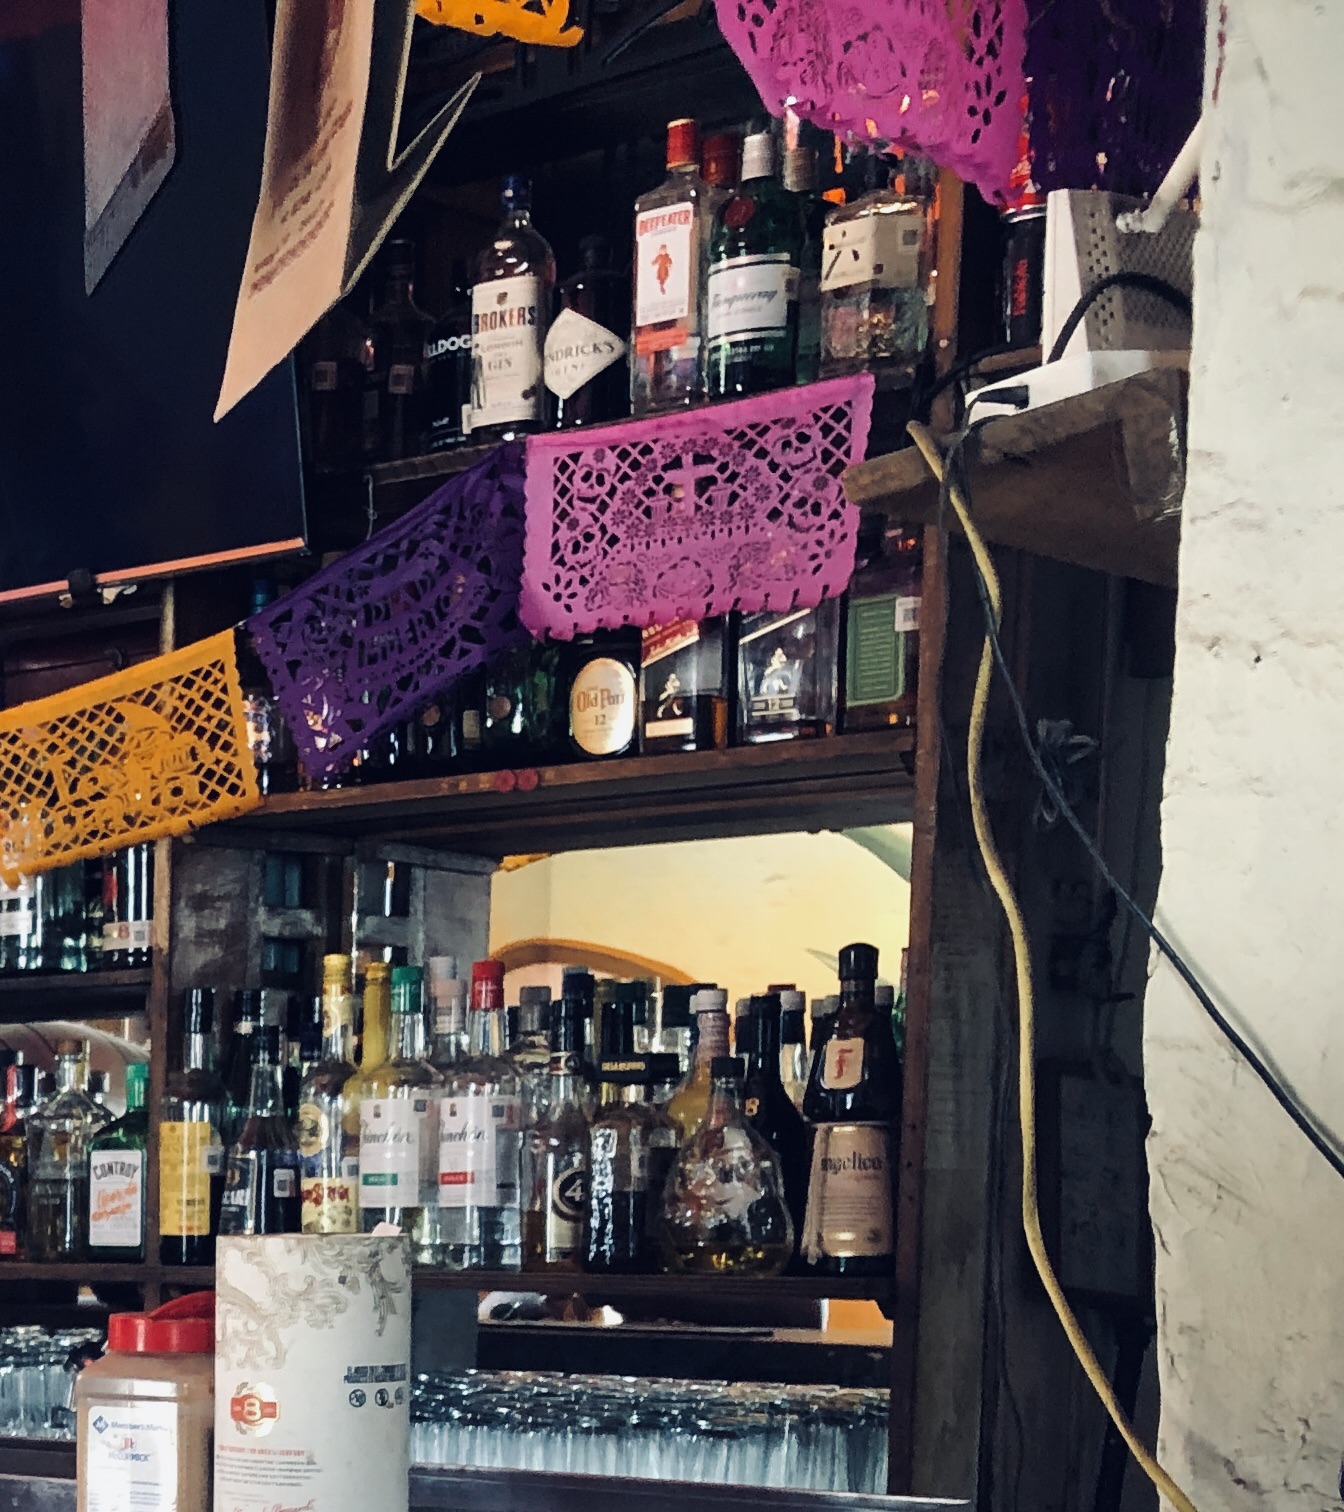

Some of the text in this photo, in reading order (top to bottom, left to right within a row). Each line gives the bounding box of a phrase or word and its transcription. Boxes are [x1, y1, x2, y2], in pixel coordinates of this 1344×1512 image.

[639, 209, 691, 236] BEEFEATER
[423, 334, 472, 359] LLDOG
[93, 1161, 140, 1180] CONTROY
